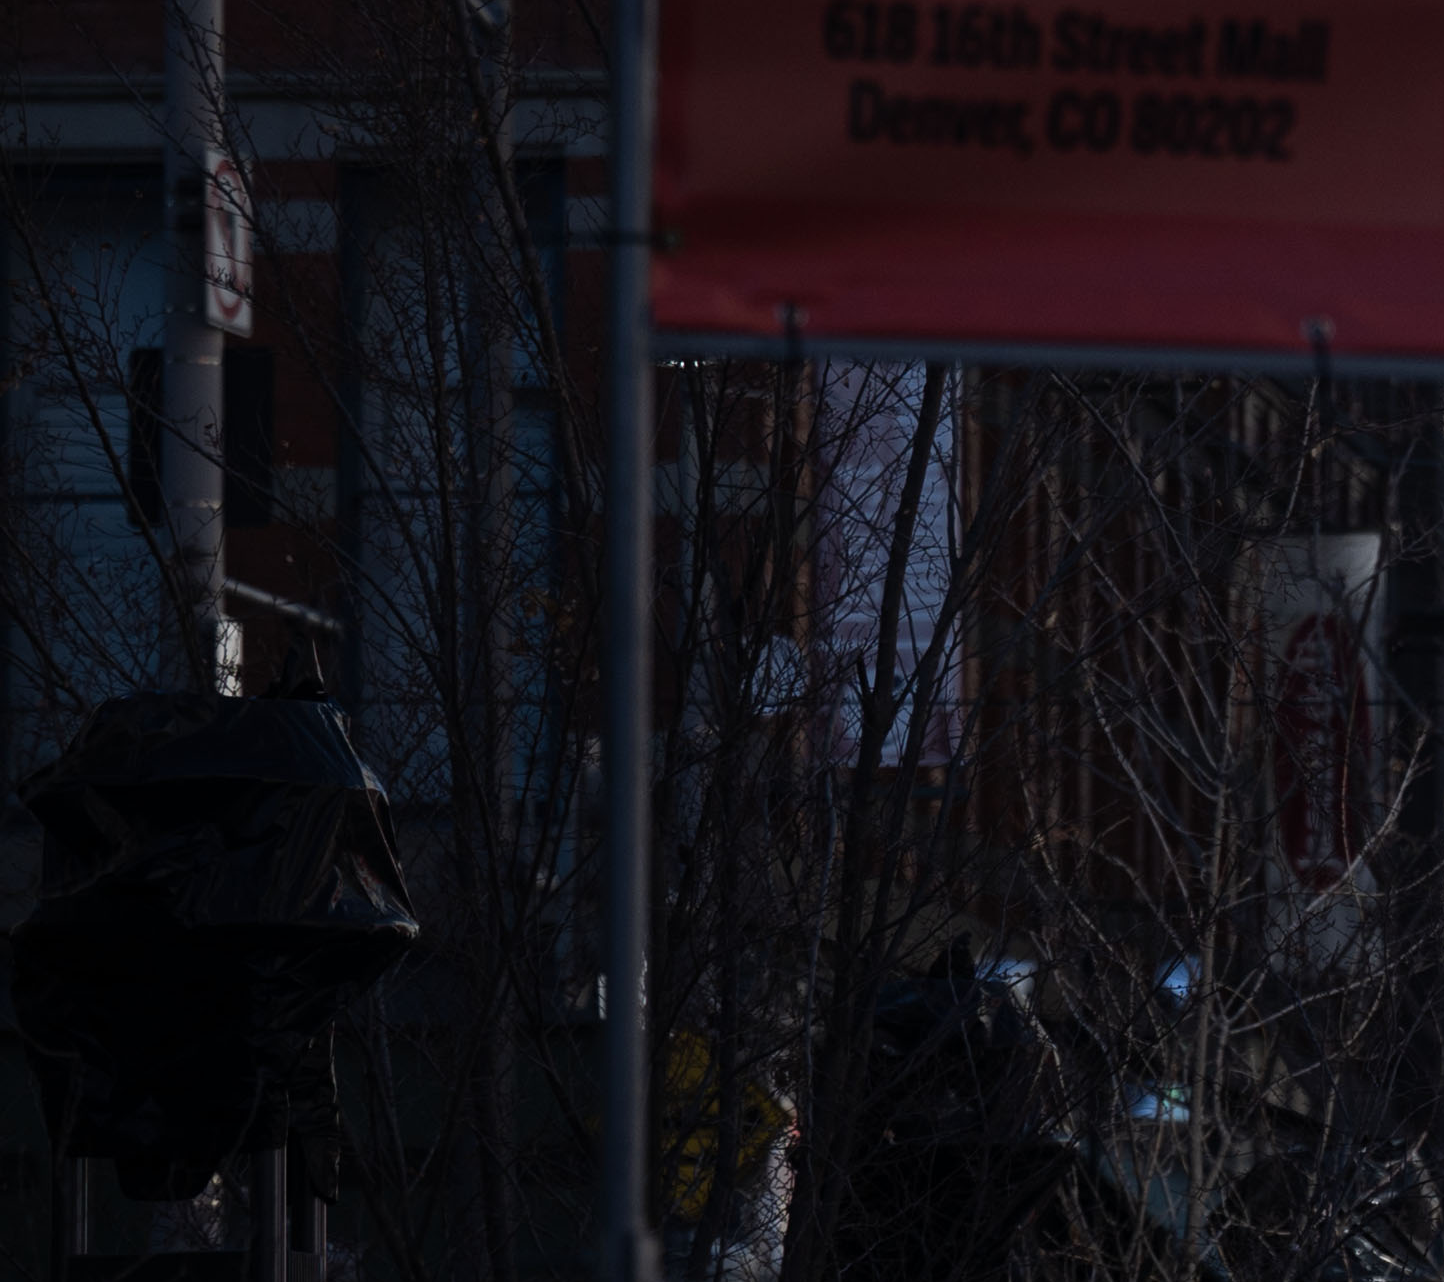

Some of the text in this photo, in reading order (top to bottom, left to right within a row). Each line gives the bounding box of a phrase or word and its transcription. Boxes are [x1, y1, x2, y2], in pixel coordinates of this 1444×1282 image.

[931, 2, 1041, 68] 16th
[1050, 7, 1207, 79] Street
[1216, 19, 1333, 84] Mall
[847, 79, 1297, 161] Denver, CO 80202
